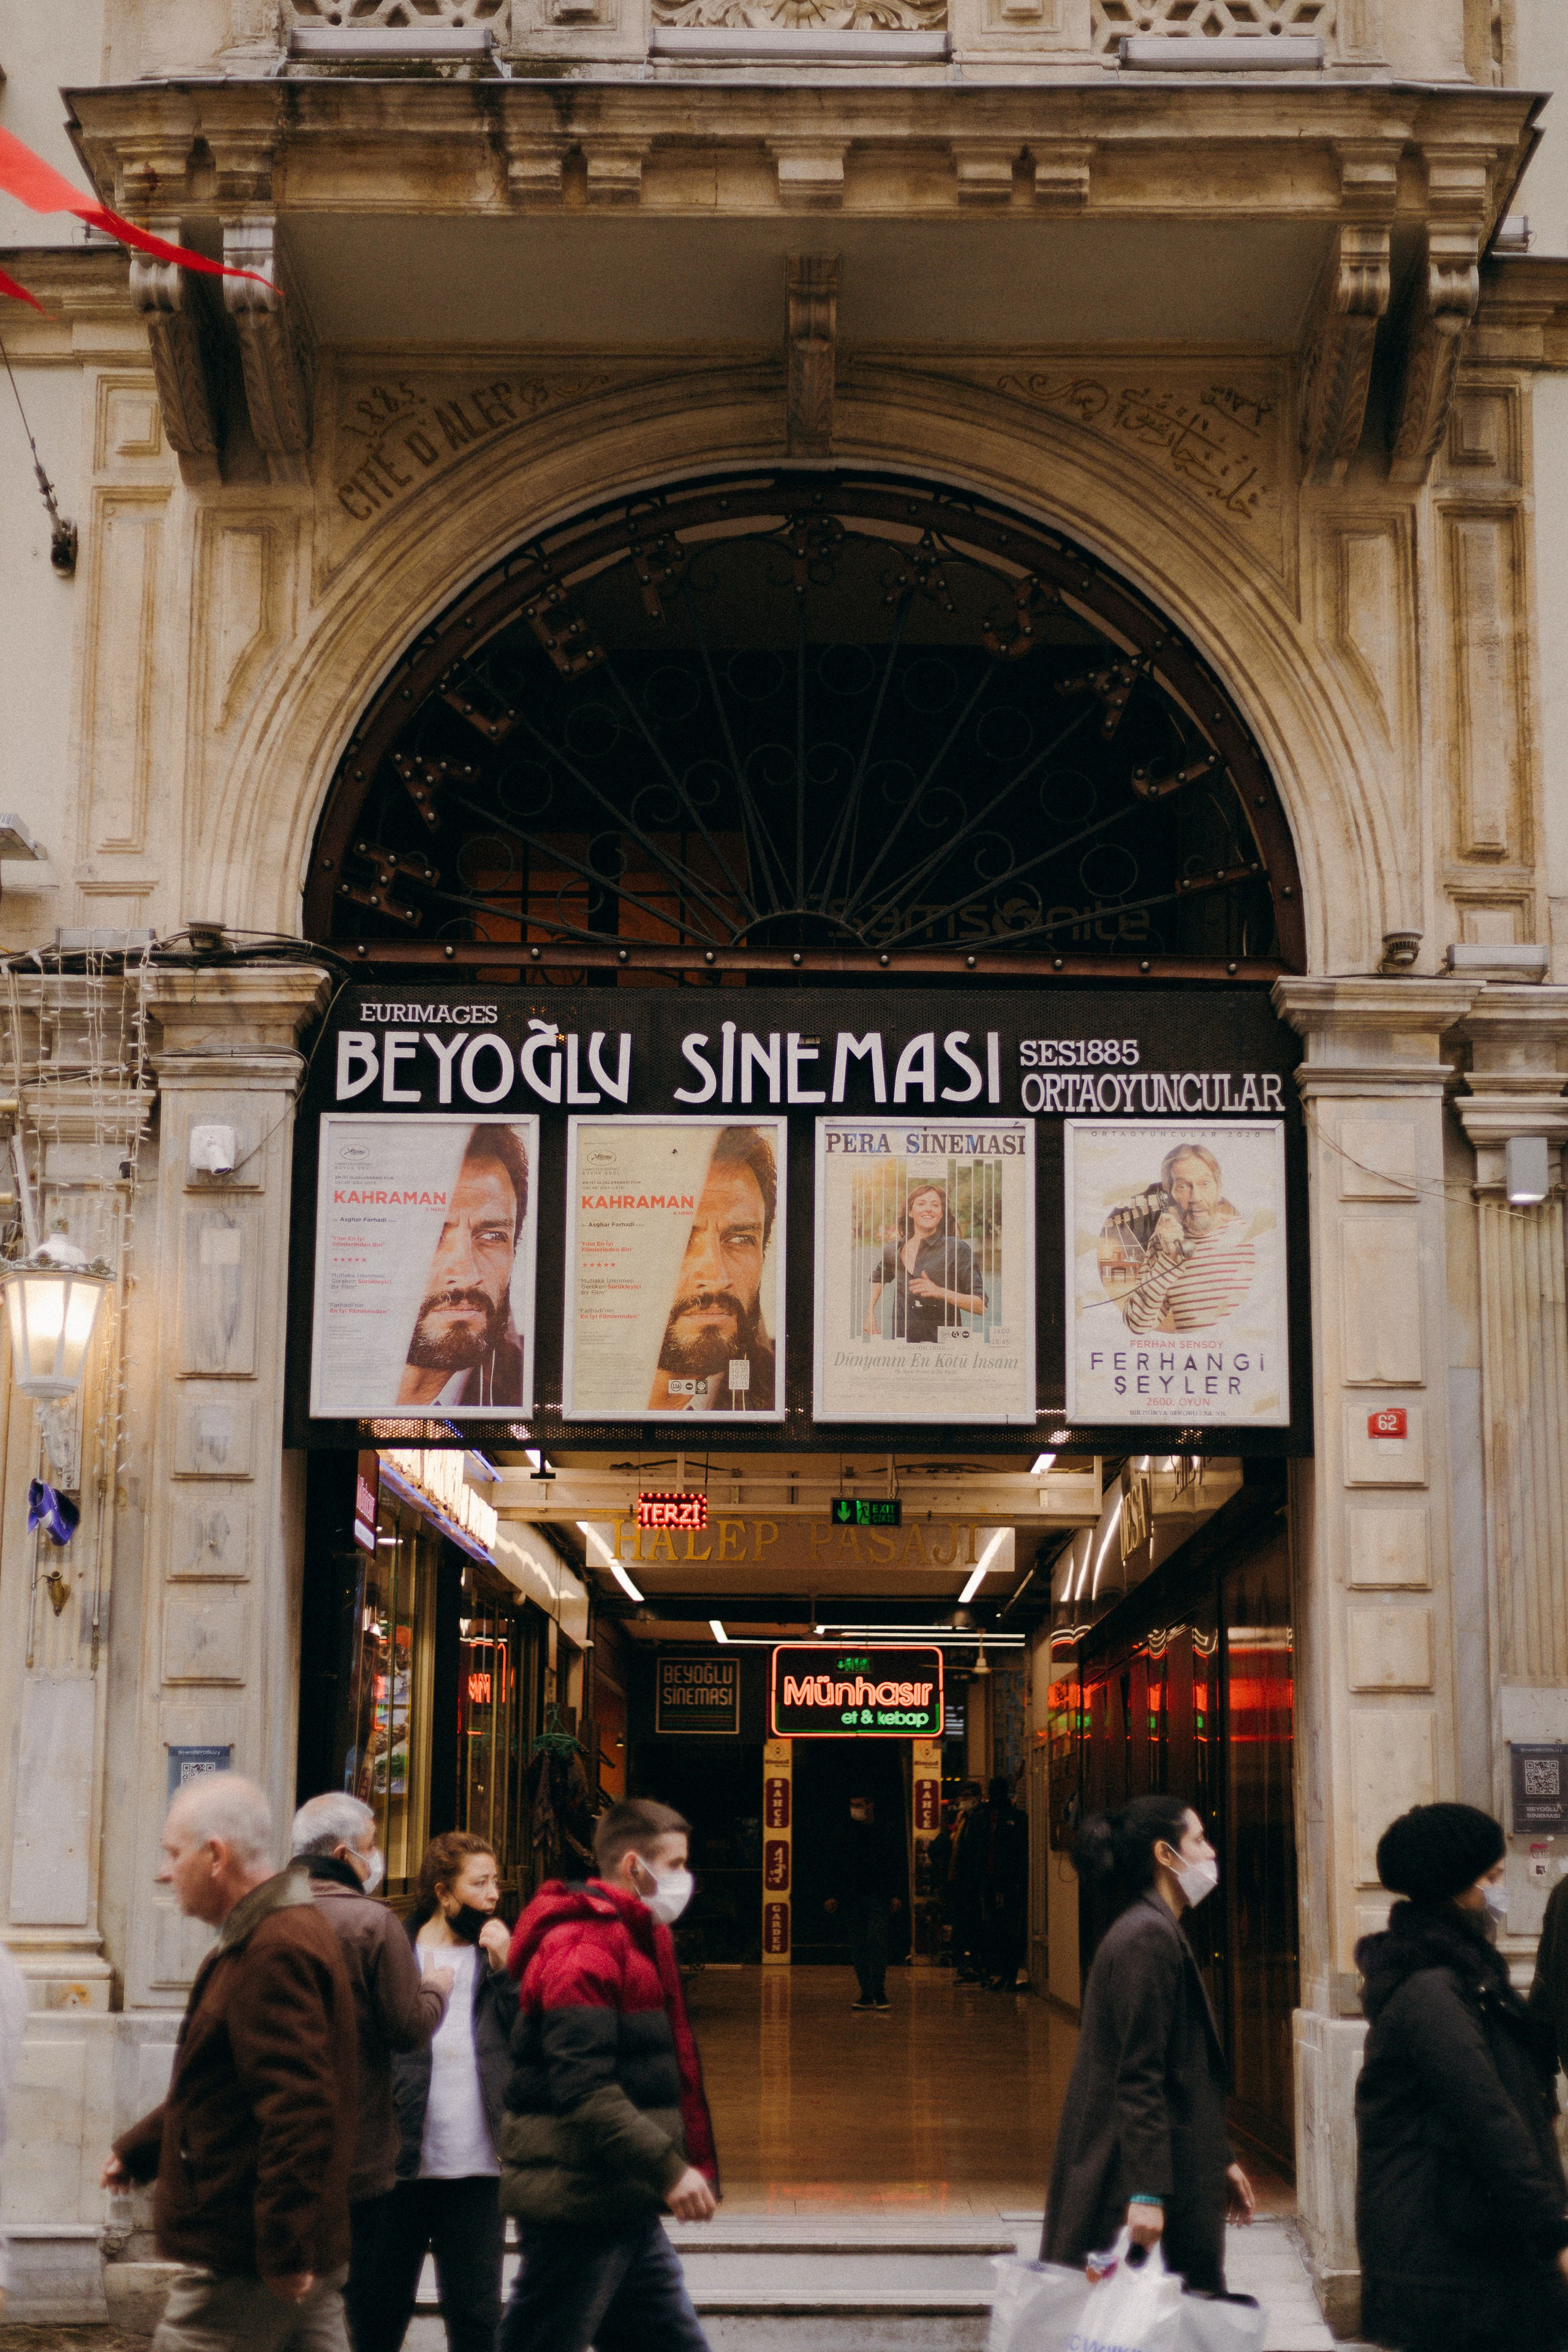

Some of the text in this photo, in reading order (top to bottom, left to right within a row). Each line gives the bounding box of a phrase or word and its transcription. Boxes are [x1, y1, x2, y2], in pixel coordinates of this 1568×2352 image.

[360, 1003, 498, 1024] EURIMAGES
[336, 1019, 1000, 1104] BEYOĞLU SİNEMASI
[1022, 1072, 1286, 1112] ORTAOYUNCULAR
[826, 1133, 892, 1153] PERA
[334, 1190, 447, 1205] KAHRAMAN
[582, 1196, 694, 1209] KAHRAMAN
[1129, 1340, 1224, 1349] FERHAN ŞENSOY
[834, 1352, 906, 1371] Dünyanın
[911, 1352, 929, 1368] En
[935, 1353, 968, 1368] Kötü
[1091, 1352, 1264, 1372] FERHANGİ
[1114, 1375, 1241, 1395] ŞEYLER
[1146, 1398, 1210, 1406] 2600. OYUN
[1378, 1414, 1397, 1431] 62
[641, 1499, 701, 1525] TERZİ
[872, 1504, 895, 1513] EXIT
[611, 1518, 980, 1566] HALEP PASAJI
[663, 1662, 733, 1684] BEYOĞLU
[783, 1675, 933, 1706] Münhasır
[841, 1709, 858, 1725] et
[860, 1709, 874, 1725] &
[876, 1709, 929, 1727] kebap
[771, 1905, 782, 1952] GARDEN
